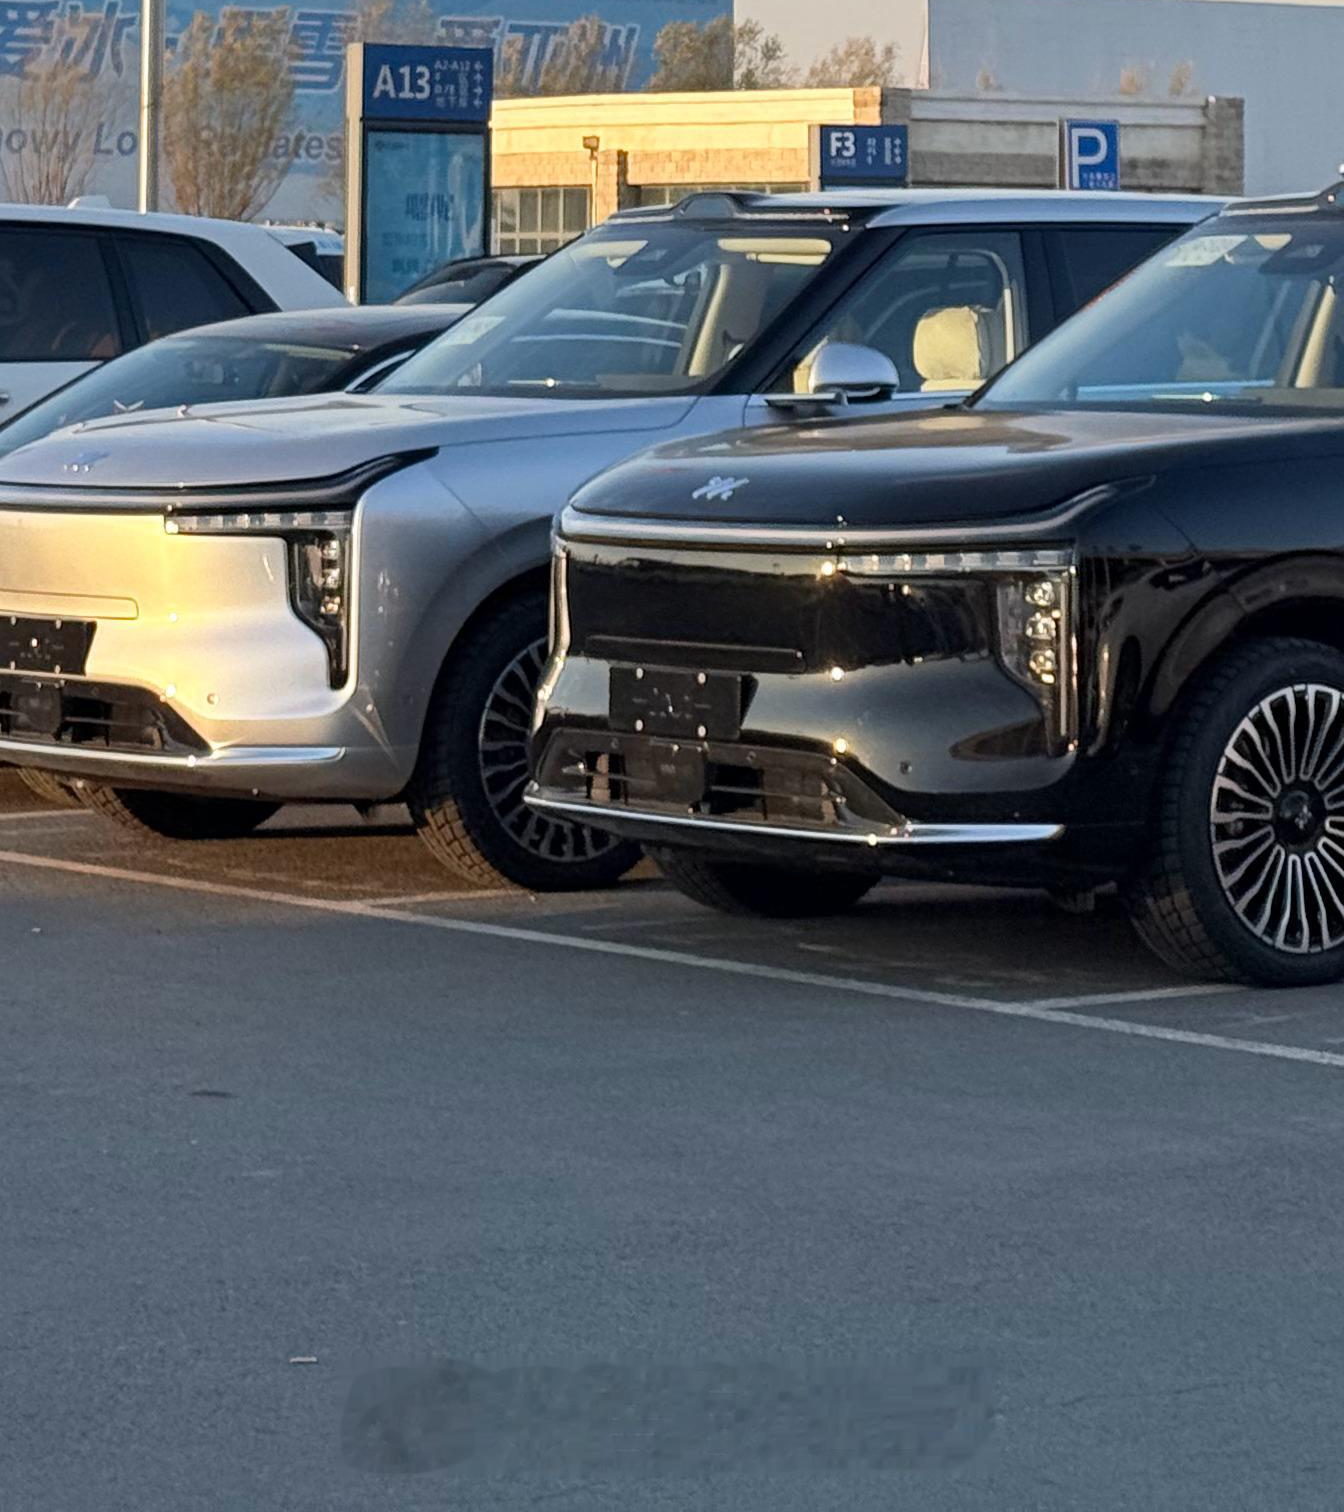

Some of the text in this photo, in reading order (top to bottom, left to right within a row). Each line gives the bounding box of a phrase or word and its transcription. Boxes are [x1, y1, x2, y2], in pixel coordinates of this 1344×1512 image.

[373, 64, 431, 100] A13
[830, 131, 856, 157] F3
[1071, 128, 1107, 188] P
